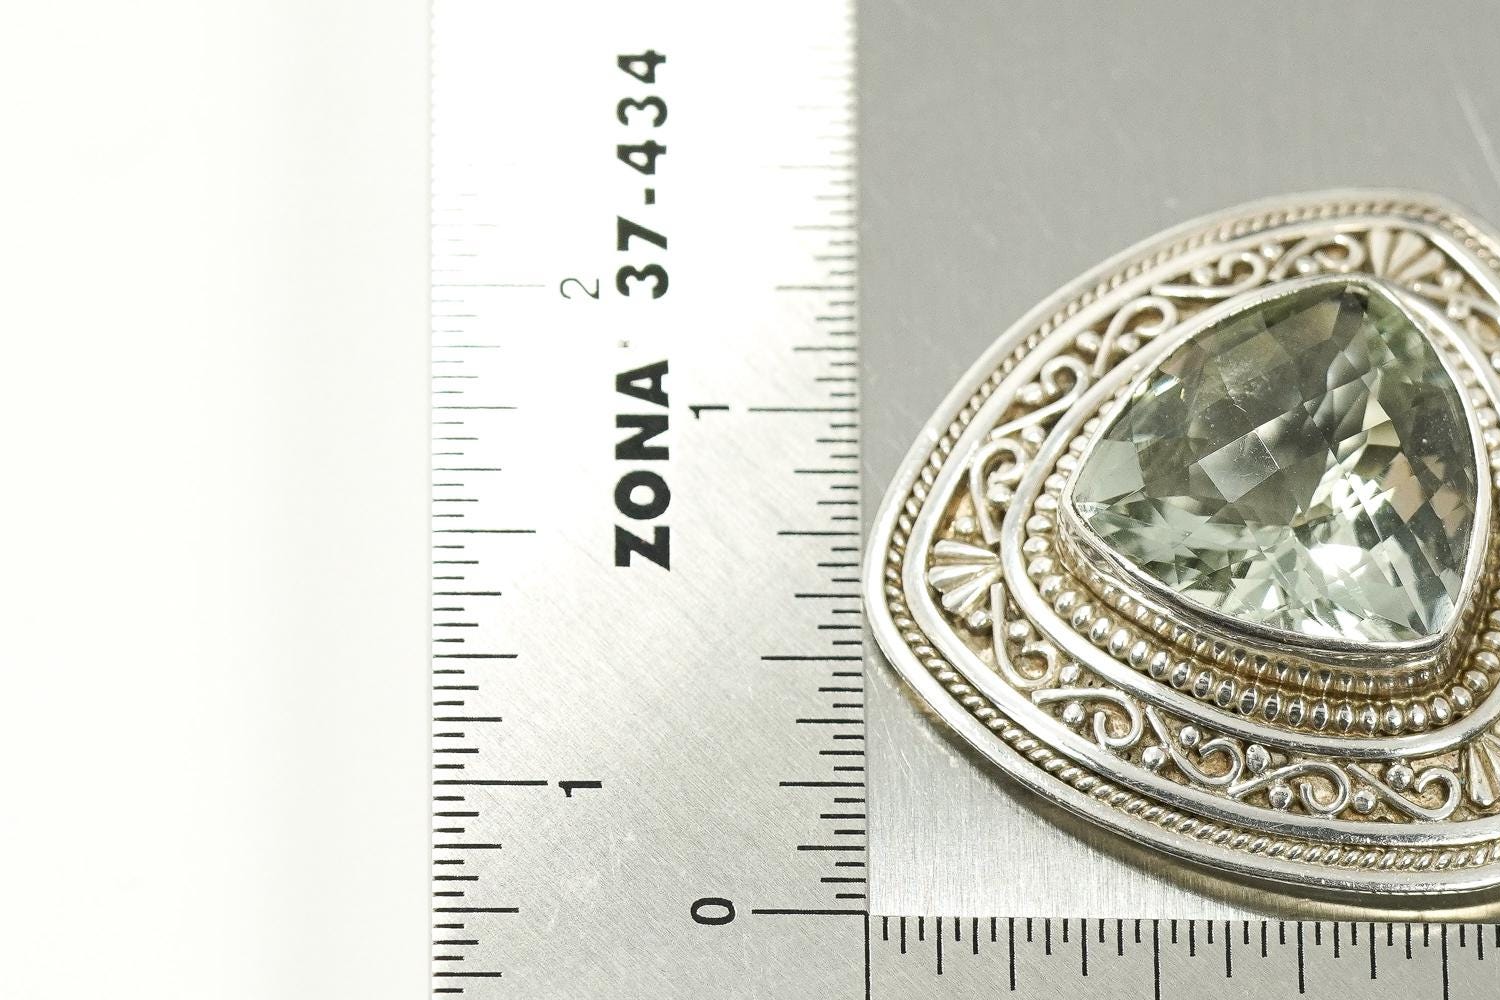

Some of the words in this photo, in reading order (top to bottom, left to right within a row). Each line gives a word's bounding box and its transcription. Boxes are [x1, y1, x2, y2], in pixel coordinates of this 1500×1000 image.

[615, 49, 670, 299] 37-434
[559, 277, 600, 300] 2
[688, 404, 730, 419] 1
[614, 359, 671, 572] ZONA
[558, 780, 603, 798] 1
[690, 897, 736, 926] 0
